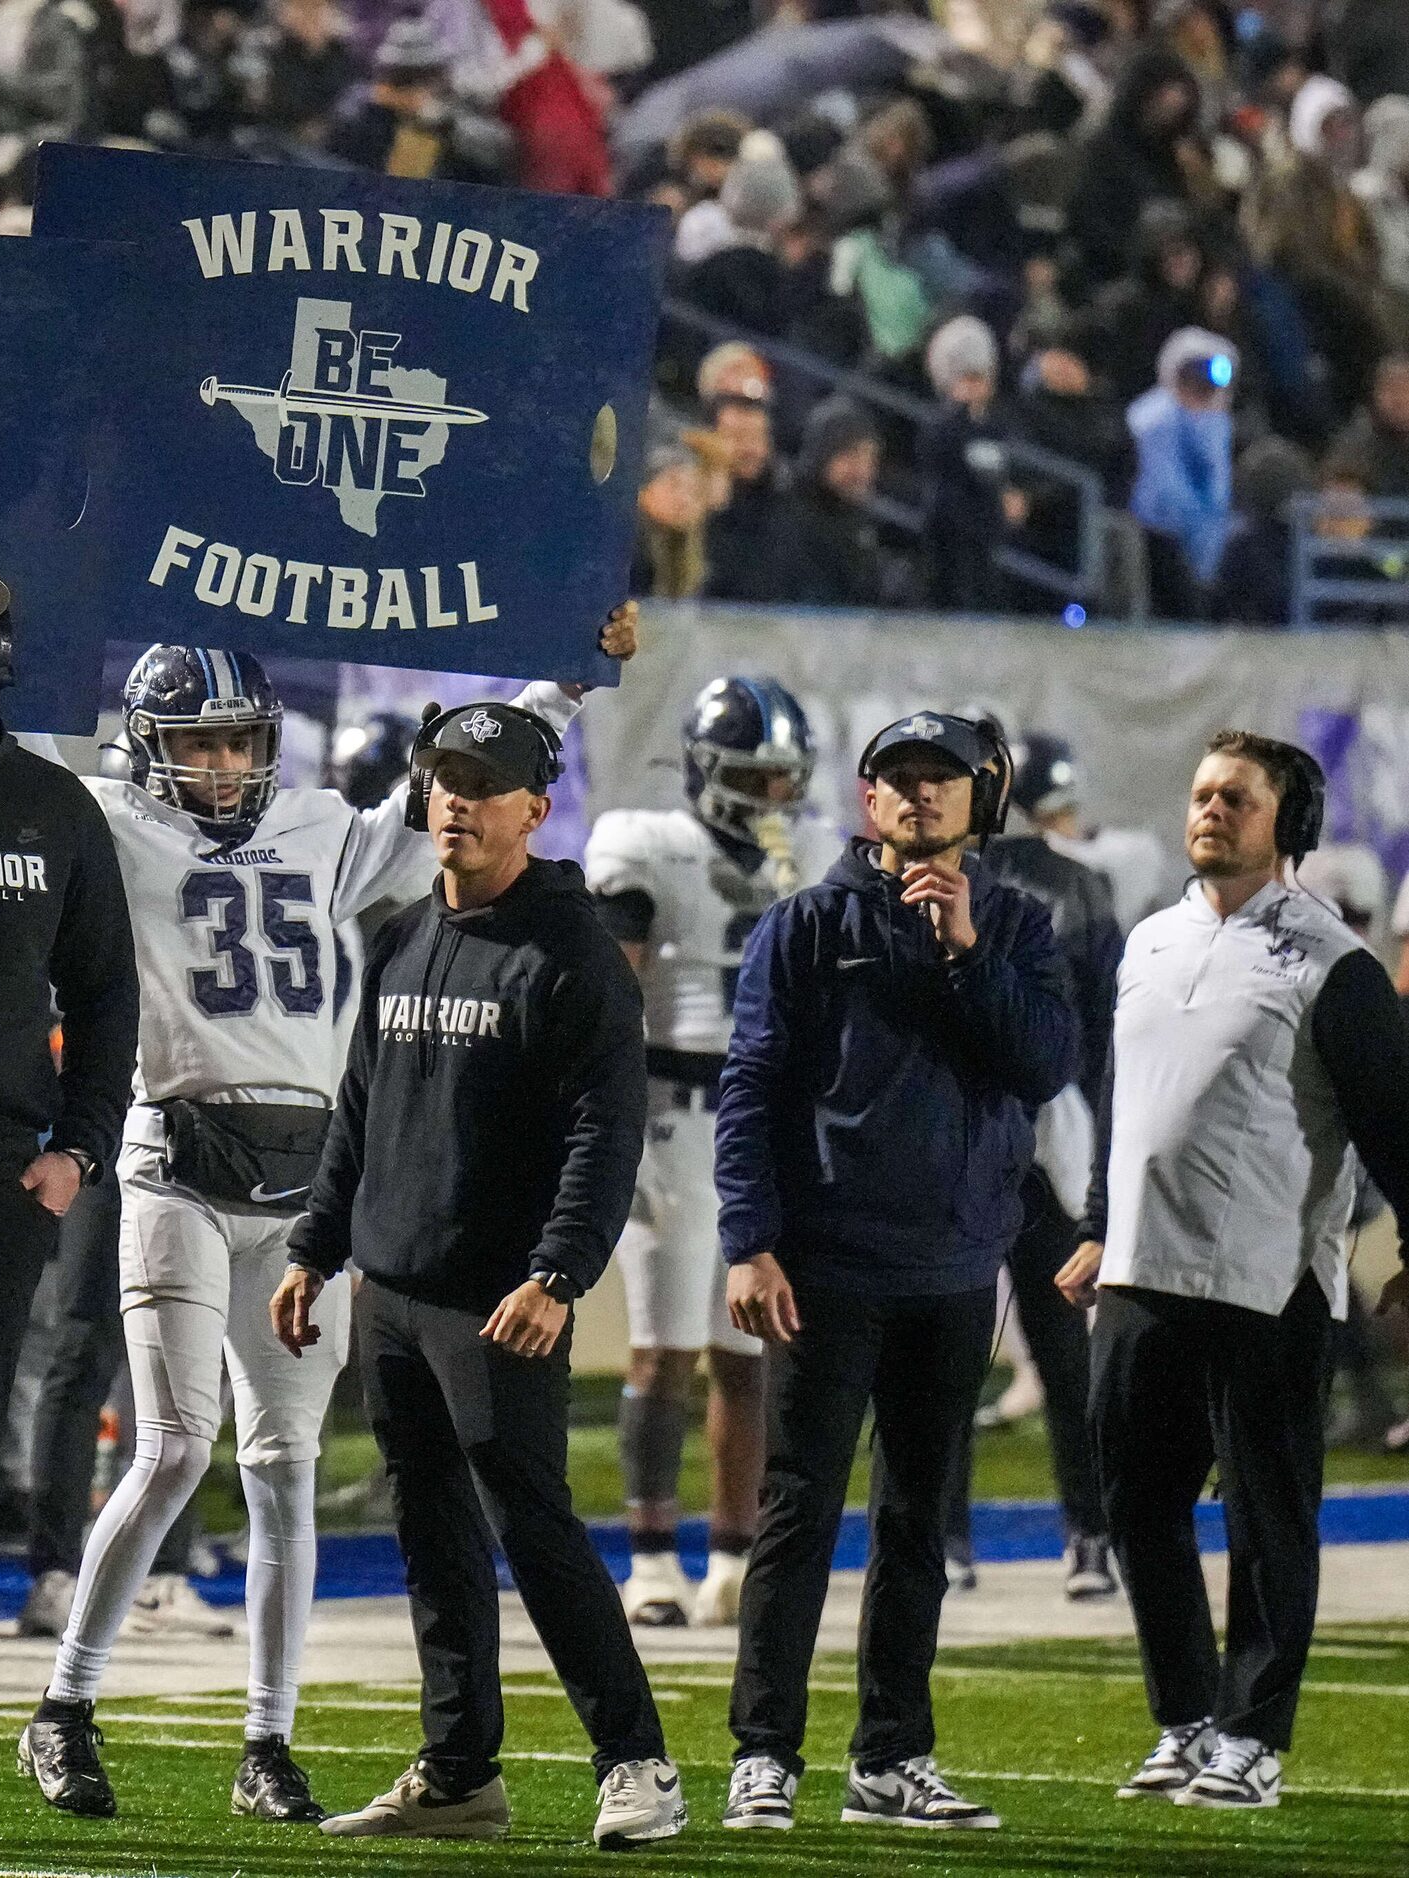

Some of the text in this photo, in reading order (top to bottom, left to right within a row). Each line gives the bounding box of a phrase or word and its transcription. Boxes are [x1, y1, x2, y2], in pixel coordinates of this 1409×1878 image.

[181, 208, 540, 312] WARRIOR
[314, 327, 402, 398] BE
[273, 413, 426, 498] ONE
[148, 525, 499, 630] FOOTBALL
[177, 867, 324, 1020] 35
[383, 1031, 473, 1048] FOOALL
